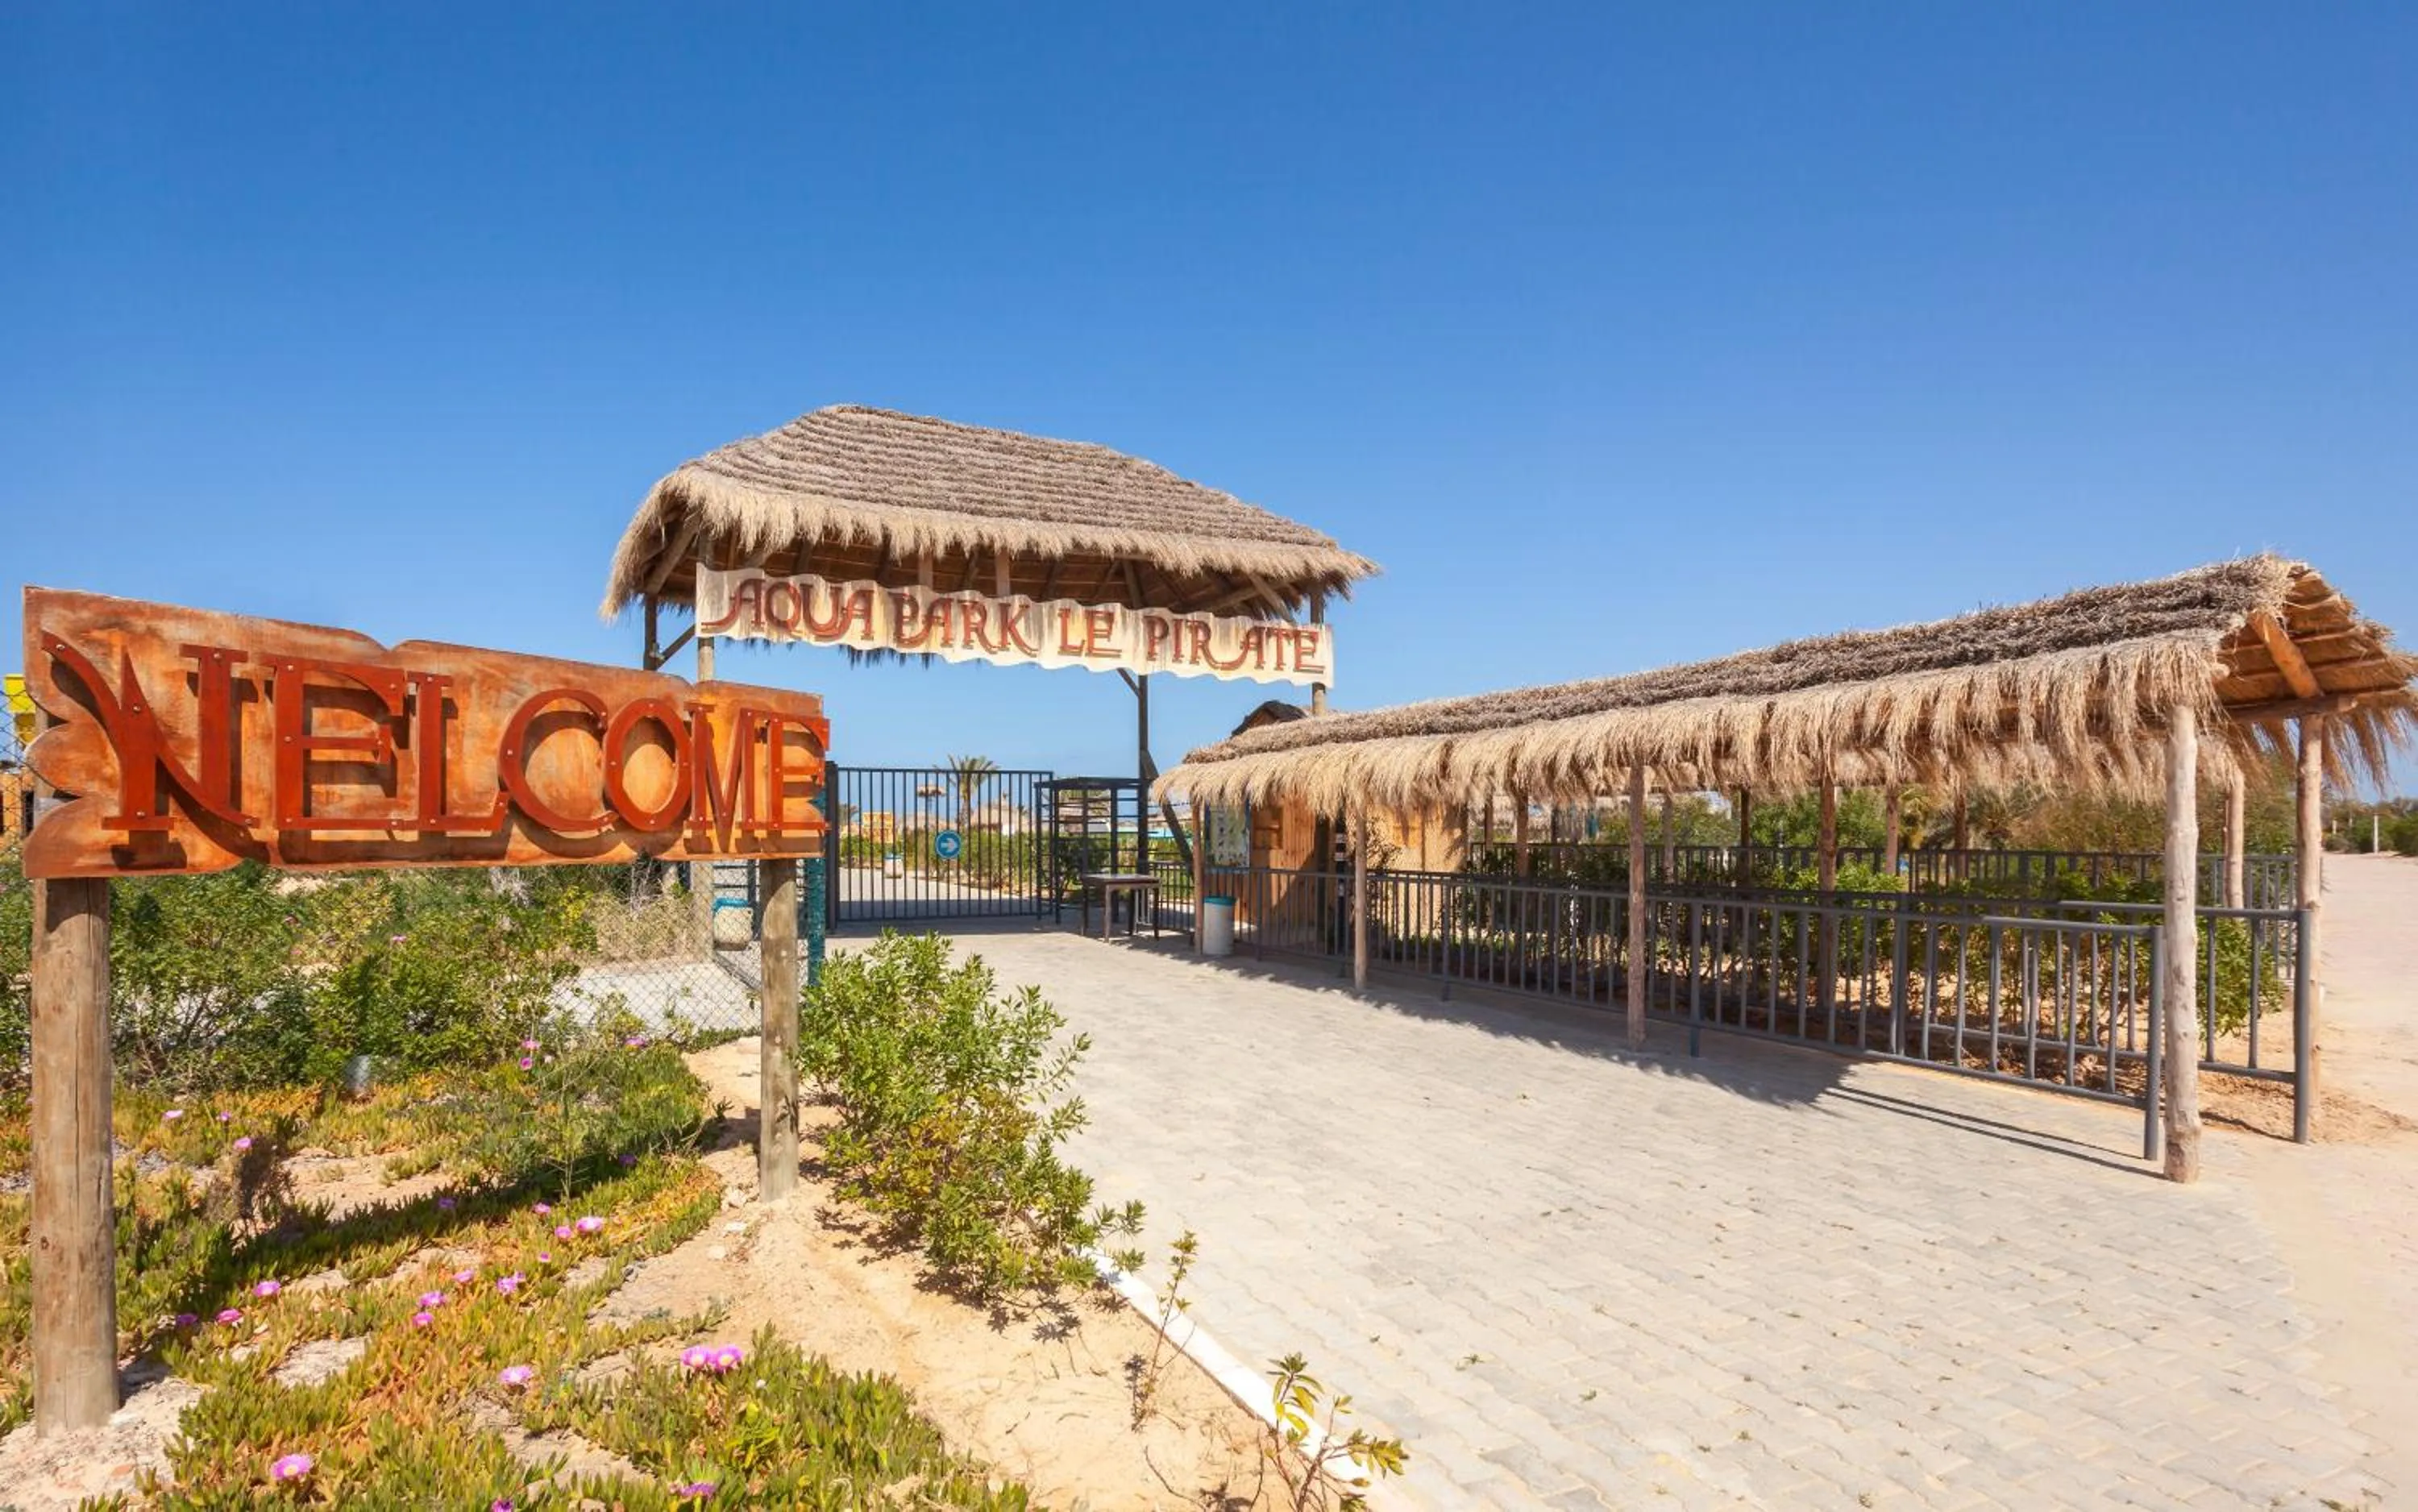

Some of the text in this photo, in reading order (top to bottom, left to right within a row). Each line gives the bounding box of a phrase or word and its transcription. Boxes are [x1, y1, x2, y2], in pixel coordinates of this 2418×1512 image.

[700, 578, 1326, 675] AQUA PARK LE PIRATE
[41, 629, 831, 833] WELCOME
